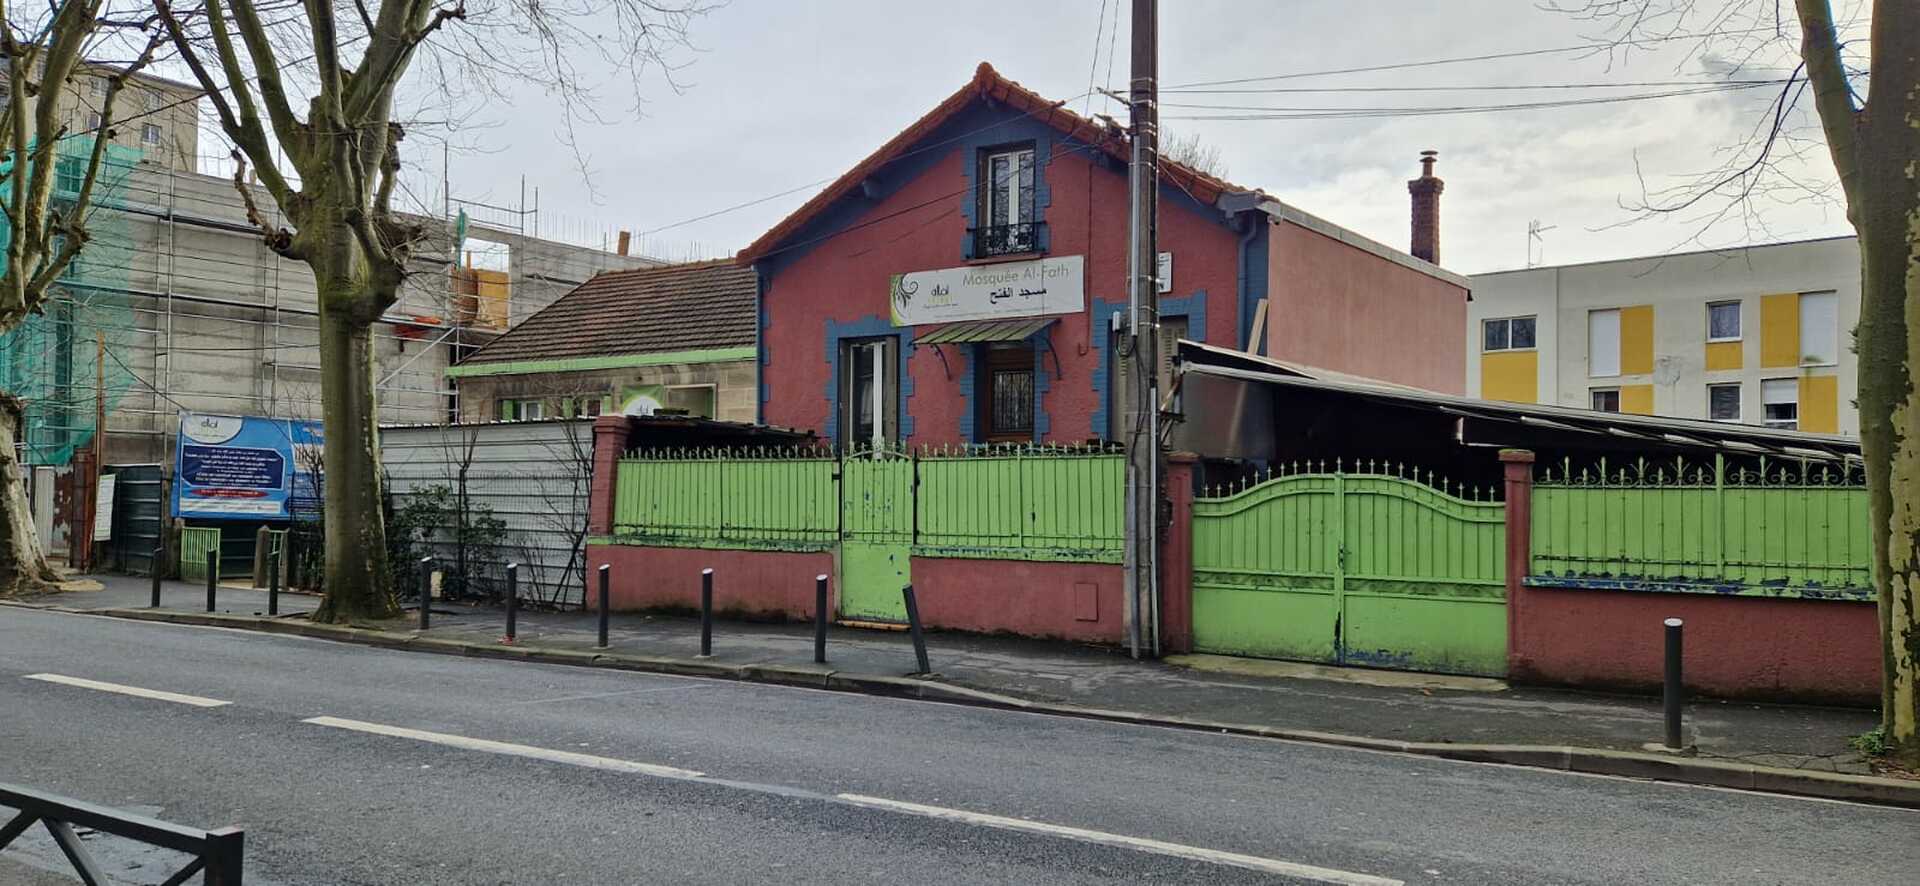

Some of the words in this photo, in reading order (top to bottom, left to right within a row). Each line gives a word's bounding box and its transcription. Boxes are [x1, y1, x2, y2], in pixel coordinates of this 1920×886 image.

[962, 268, 1019, 287] Mosquée
[1024, 263, 1070, 280] Al-Fath
[989, 286, 1014, 305] الفتح
[1018, 287, 1048, 300] مسجد
